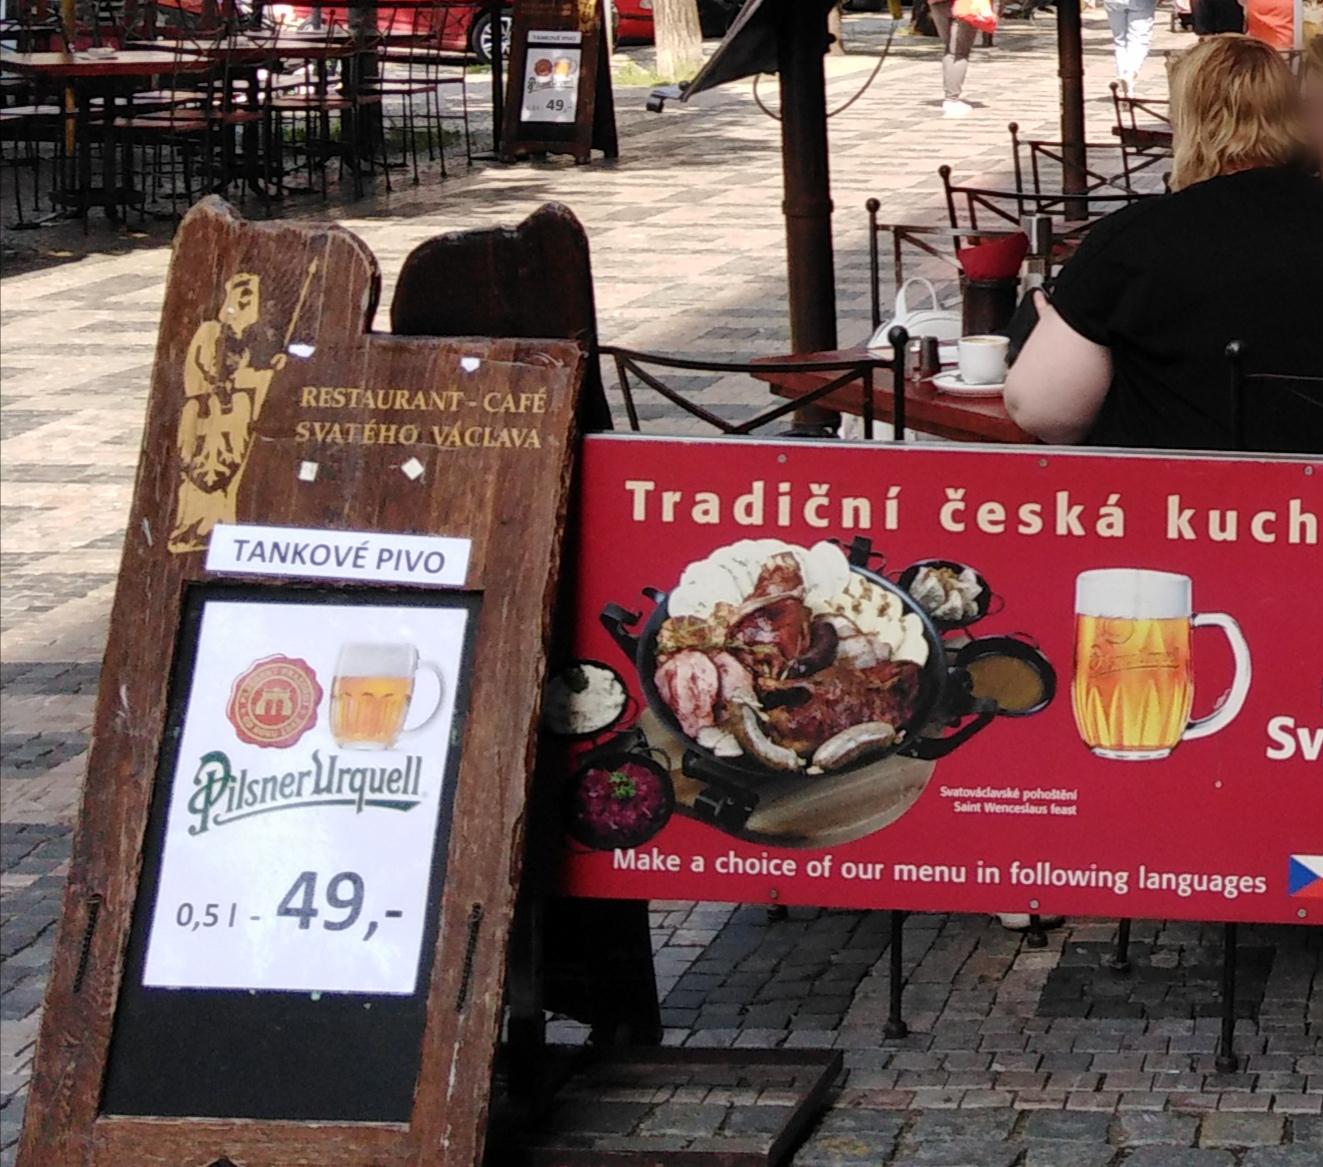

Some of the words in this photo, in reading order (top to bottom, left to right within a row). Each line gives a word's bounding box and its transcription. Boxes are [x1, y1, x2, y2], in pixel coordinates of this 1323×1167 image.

[299, 386, 465, 413] RESTAURANT
[483, 387, 548, 413] CAFÉ
[295, 419, 419, 445] SVATÉHO
[432, 420, 542, 448] VÁCLAVA
[624, 480, 902, 531] Tradiční
[939, 487, 1127, 538] česká
[232, 538, 371, 569] TANKOVÉ
[376, 547, 446, 573] PIVO
[187, 750, 313, 836] Pilsner
[311, 749, 423, 815] Urquell
[953, 800, 982, 813] Saint
[984, 802, 1048, 815] Wenceslaus
[1051, 803, 1077, 815] feast
[612, 848, 681, 872] Make
[690, 855, 705, 873] a
[714, 851, 797, 876] choice
[806, 855, 832, 878] of
[841, 861, 884, 880] our
[894, 862, 966, 883] menu
[977, 860, 1000, 883] in
[1010, 862, 1129, 894] following
[1139, 865, 1267, 899] languages
[176, 902, 220, 931] 0,5
